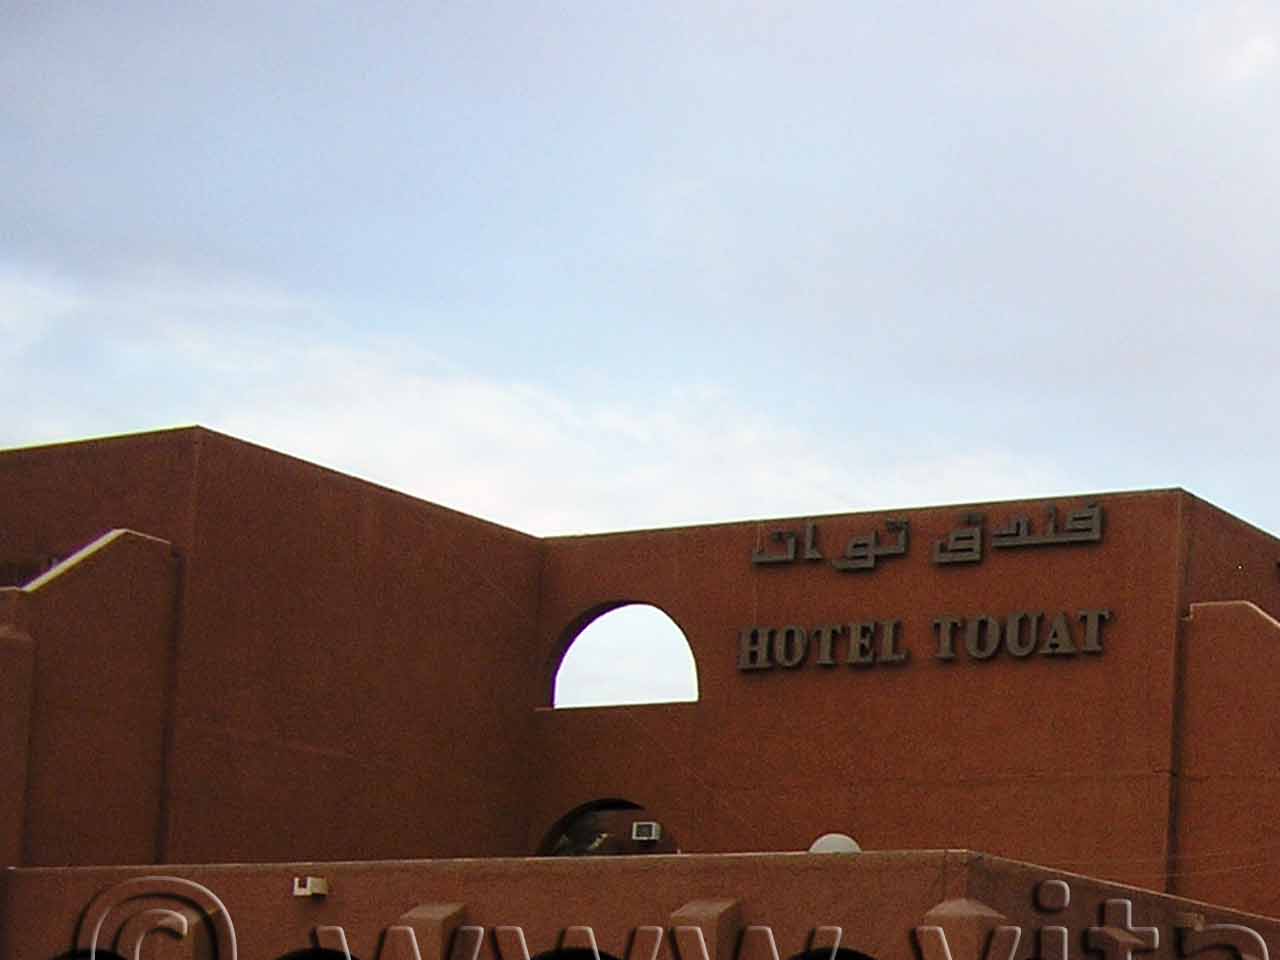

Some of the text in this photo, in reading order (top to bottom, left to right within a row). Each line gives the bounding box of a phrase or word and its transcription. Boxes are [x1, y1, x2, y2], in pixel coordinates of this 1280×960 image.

[751, 501, 1106, 571] فندق توات
[738, 608, 1111, 672] HOTEL TOUAT
